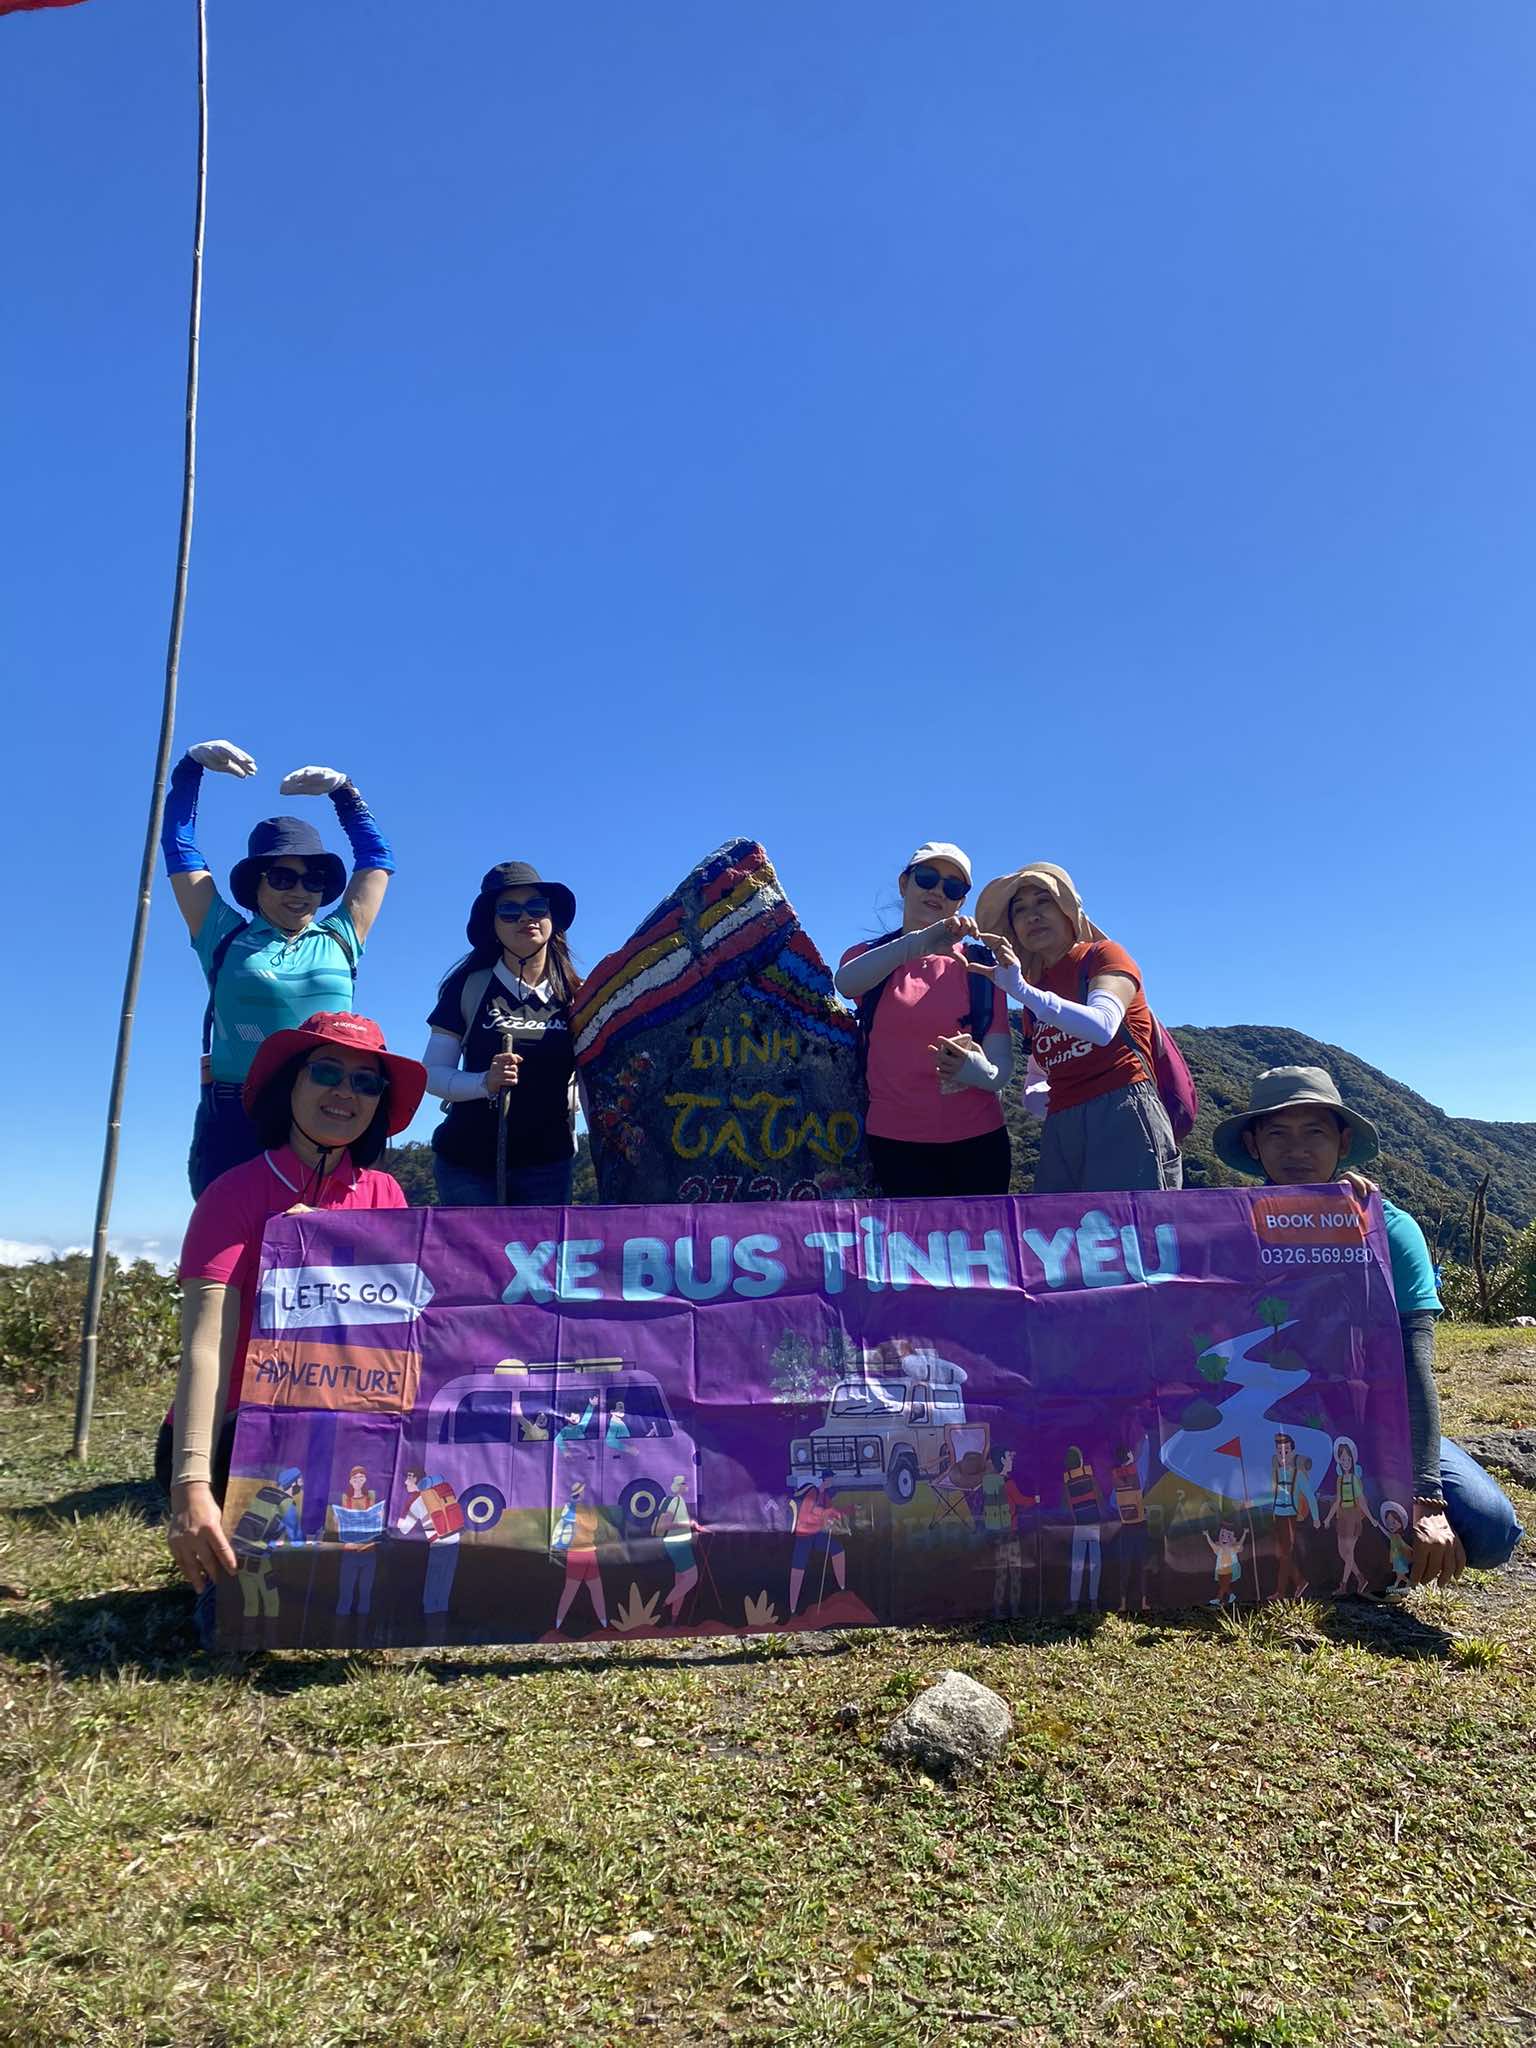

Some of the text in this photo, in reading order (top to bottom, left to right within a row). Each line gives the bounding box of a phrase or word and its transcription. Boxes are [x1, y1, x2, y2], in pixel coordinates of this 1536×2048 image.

[1265, 1212, 1360, 1229] BOOK NOW
[502, 1210, 1180, 1304] XE BUS TÌNH YÊU
[1261, 1247, 1373, 1264] 0326.569.980
[281, 1283, 398, 1311] LET'S GO
[255, 1359, 401, 1395] ADVENTURE
